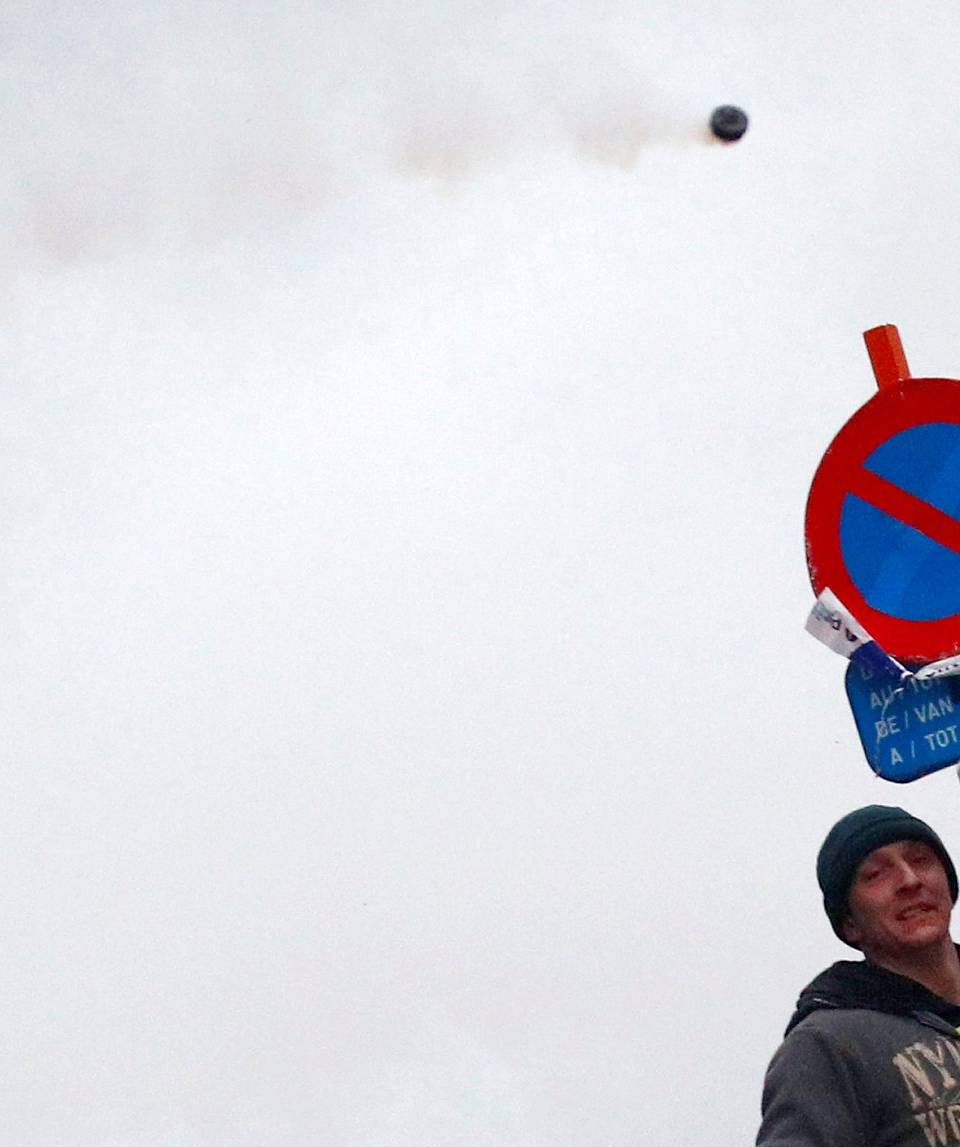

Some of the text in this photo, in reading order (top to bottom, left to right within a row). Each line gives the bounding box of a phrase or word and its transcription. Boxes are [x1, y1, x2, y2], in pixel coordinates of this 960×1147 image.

[914, 696, 954, 724] VAN
[890, 747, 904, 766] A
[924, 725, 960, 751] TOT
